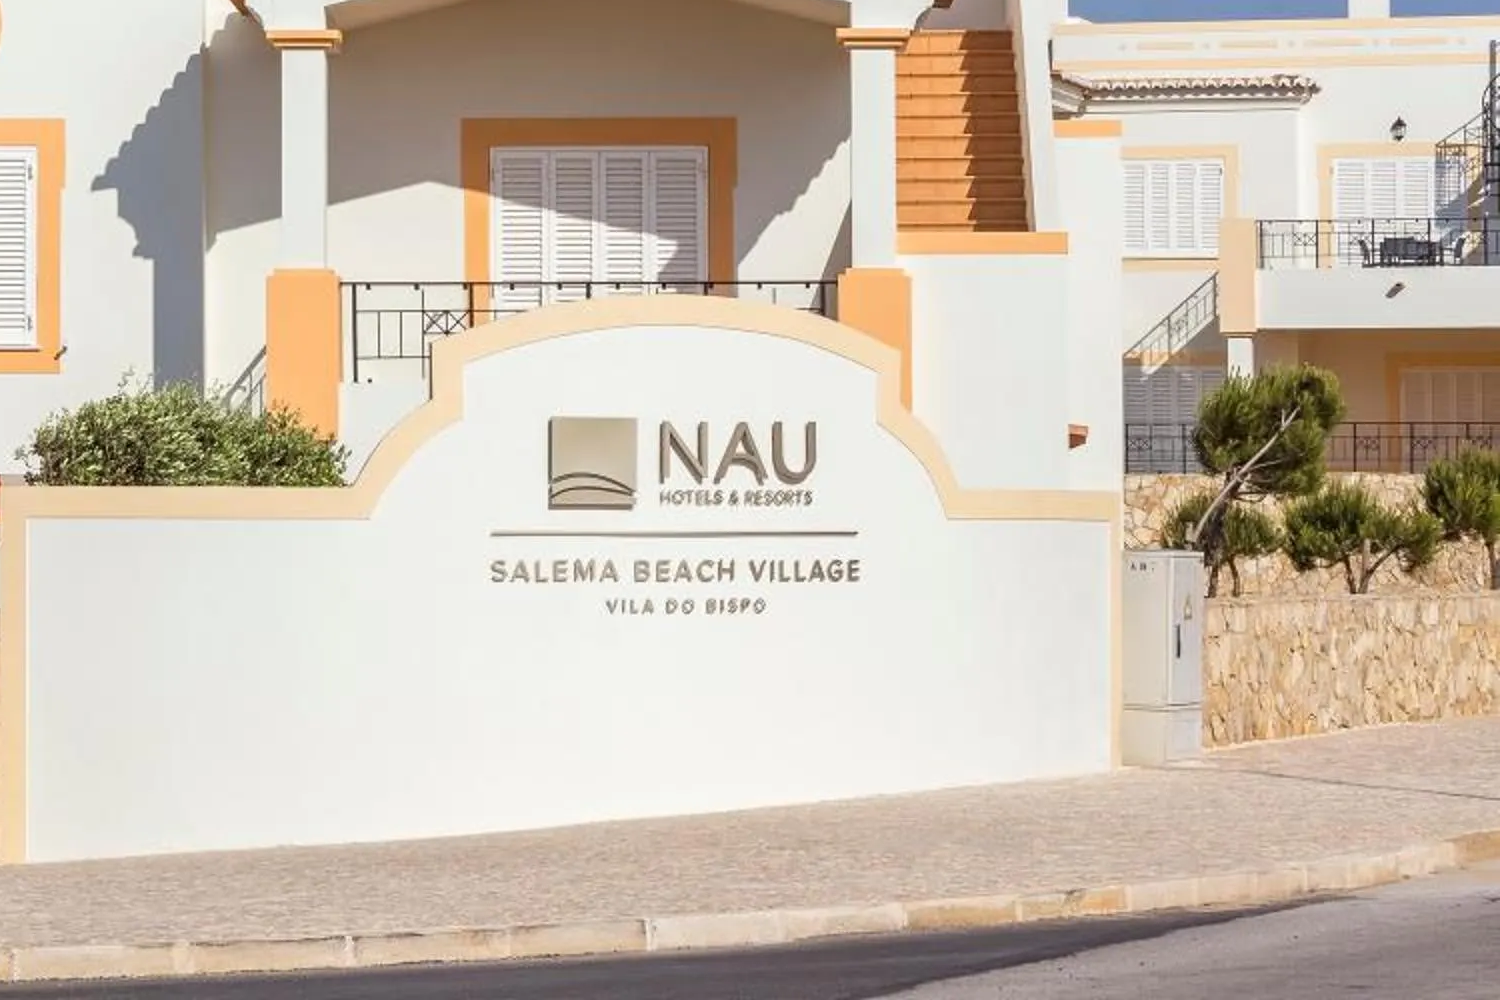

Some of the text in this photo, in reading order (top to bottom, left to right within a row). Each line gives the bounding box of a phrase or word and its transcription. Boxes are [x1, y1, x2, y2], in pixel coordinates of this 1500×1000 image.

[659, 421, 817, 485] NAU
[659, 490, 813, 506] HOTELS & RESORTS
[490, 559, 861, 583] SALEMA BEACH VILLAGE
[605, 598, 767, 615] VILA DO BISPO
